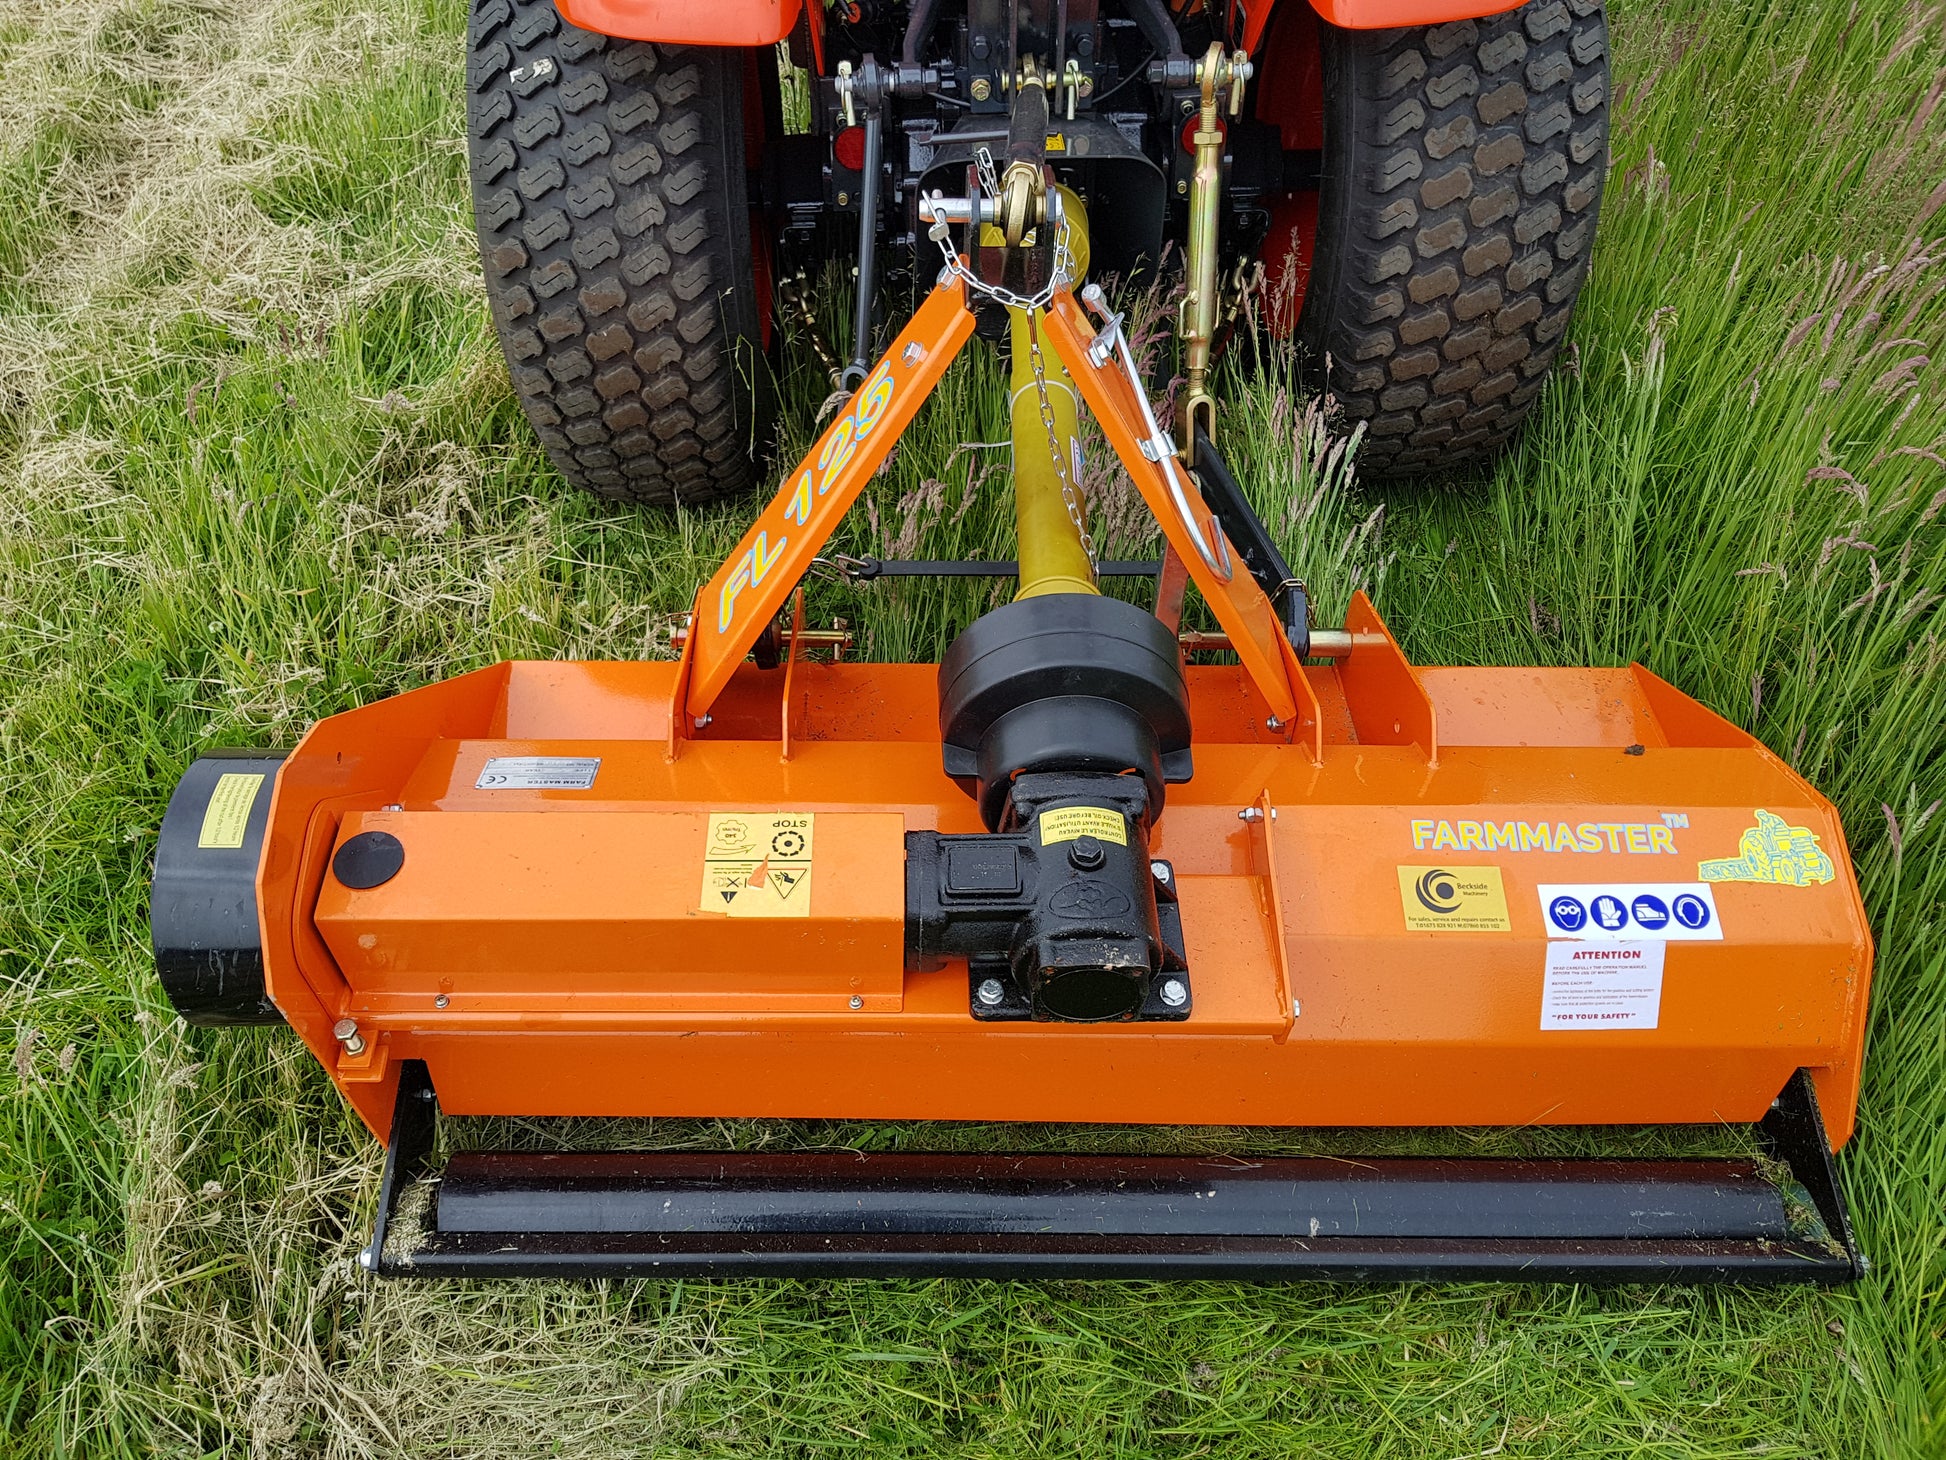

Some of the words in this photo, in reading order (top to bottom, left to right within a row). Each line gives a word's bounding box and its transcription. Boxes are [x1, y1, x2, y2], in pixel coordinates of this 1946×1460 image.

[718, 529, 787, 634] FL
[784, 359, 895, 526] 125
[772, 820, 808, 828] STOP
[1411, 819, 1678, 855] FARMMASTER
[1456, 882, 1489, 890] Beckside
[1462, 890, 1489, 898] Machinery
[1572, 949, 1642, 960] ATTENTION
